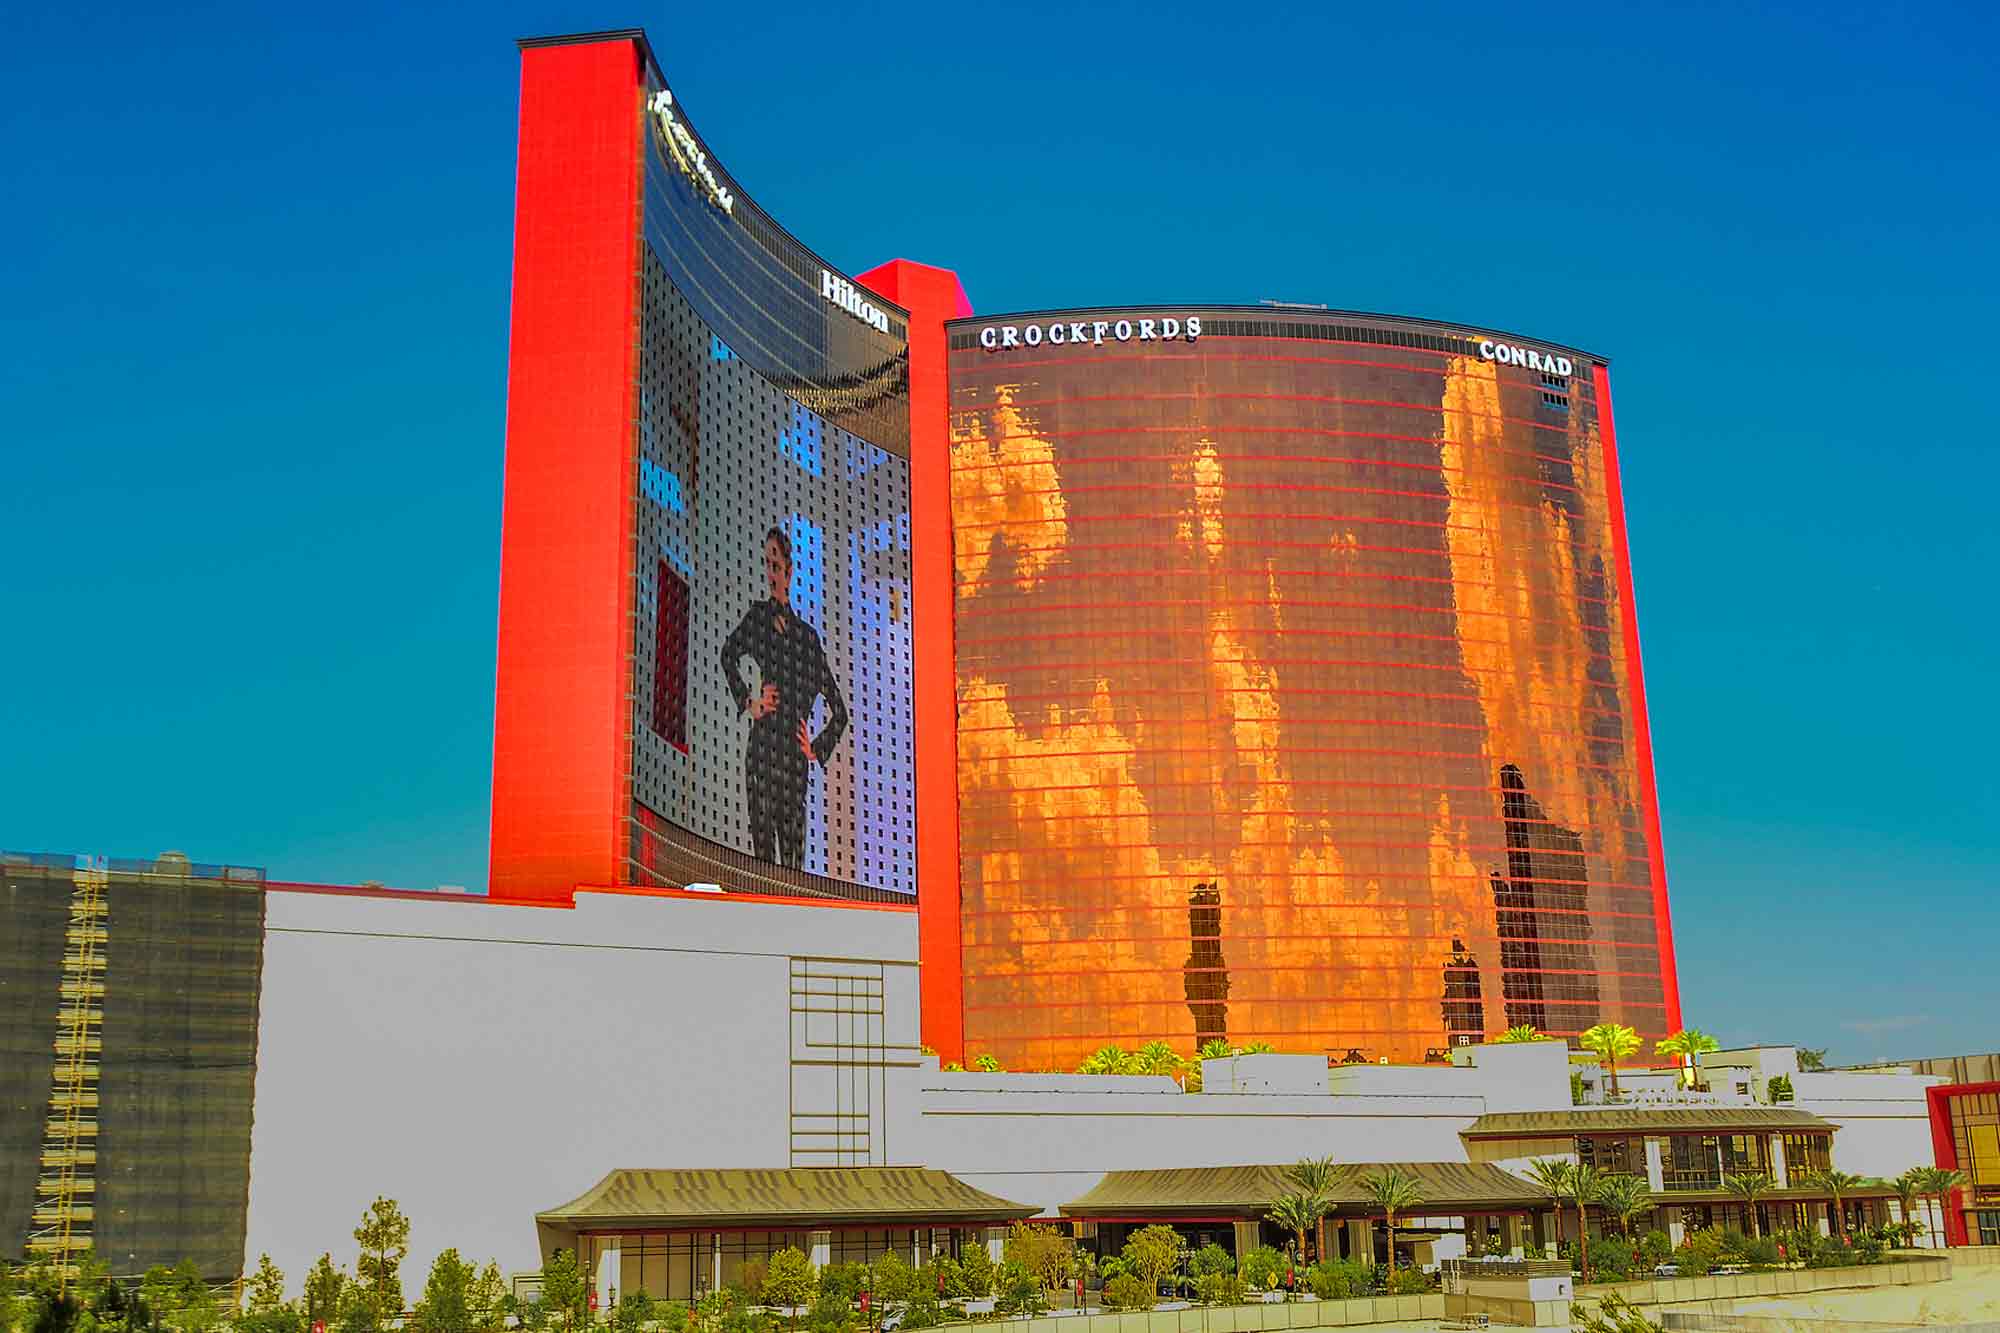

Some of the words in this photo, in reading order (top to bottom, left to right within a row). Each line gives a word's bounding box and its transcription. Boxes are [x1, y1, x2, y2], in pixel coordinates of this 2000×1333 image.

[821, 269, 890, 333] Hilton
[980, 316, 1202, 347] CROCKFORDS
[1479, 340, 1572, 376] CONRAD
